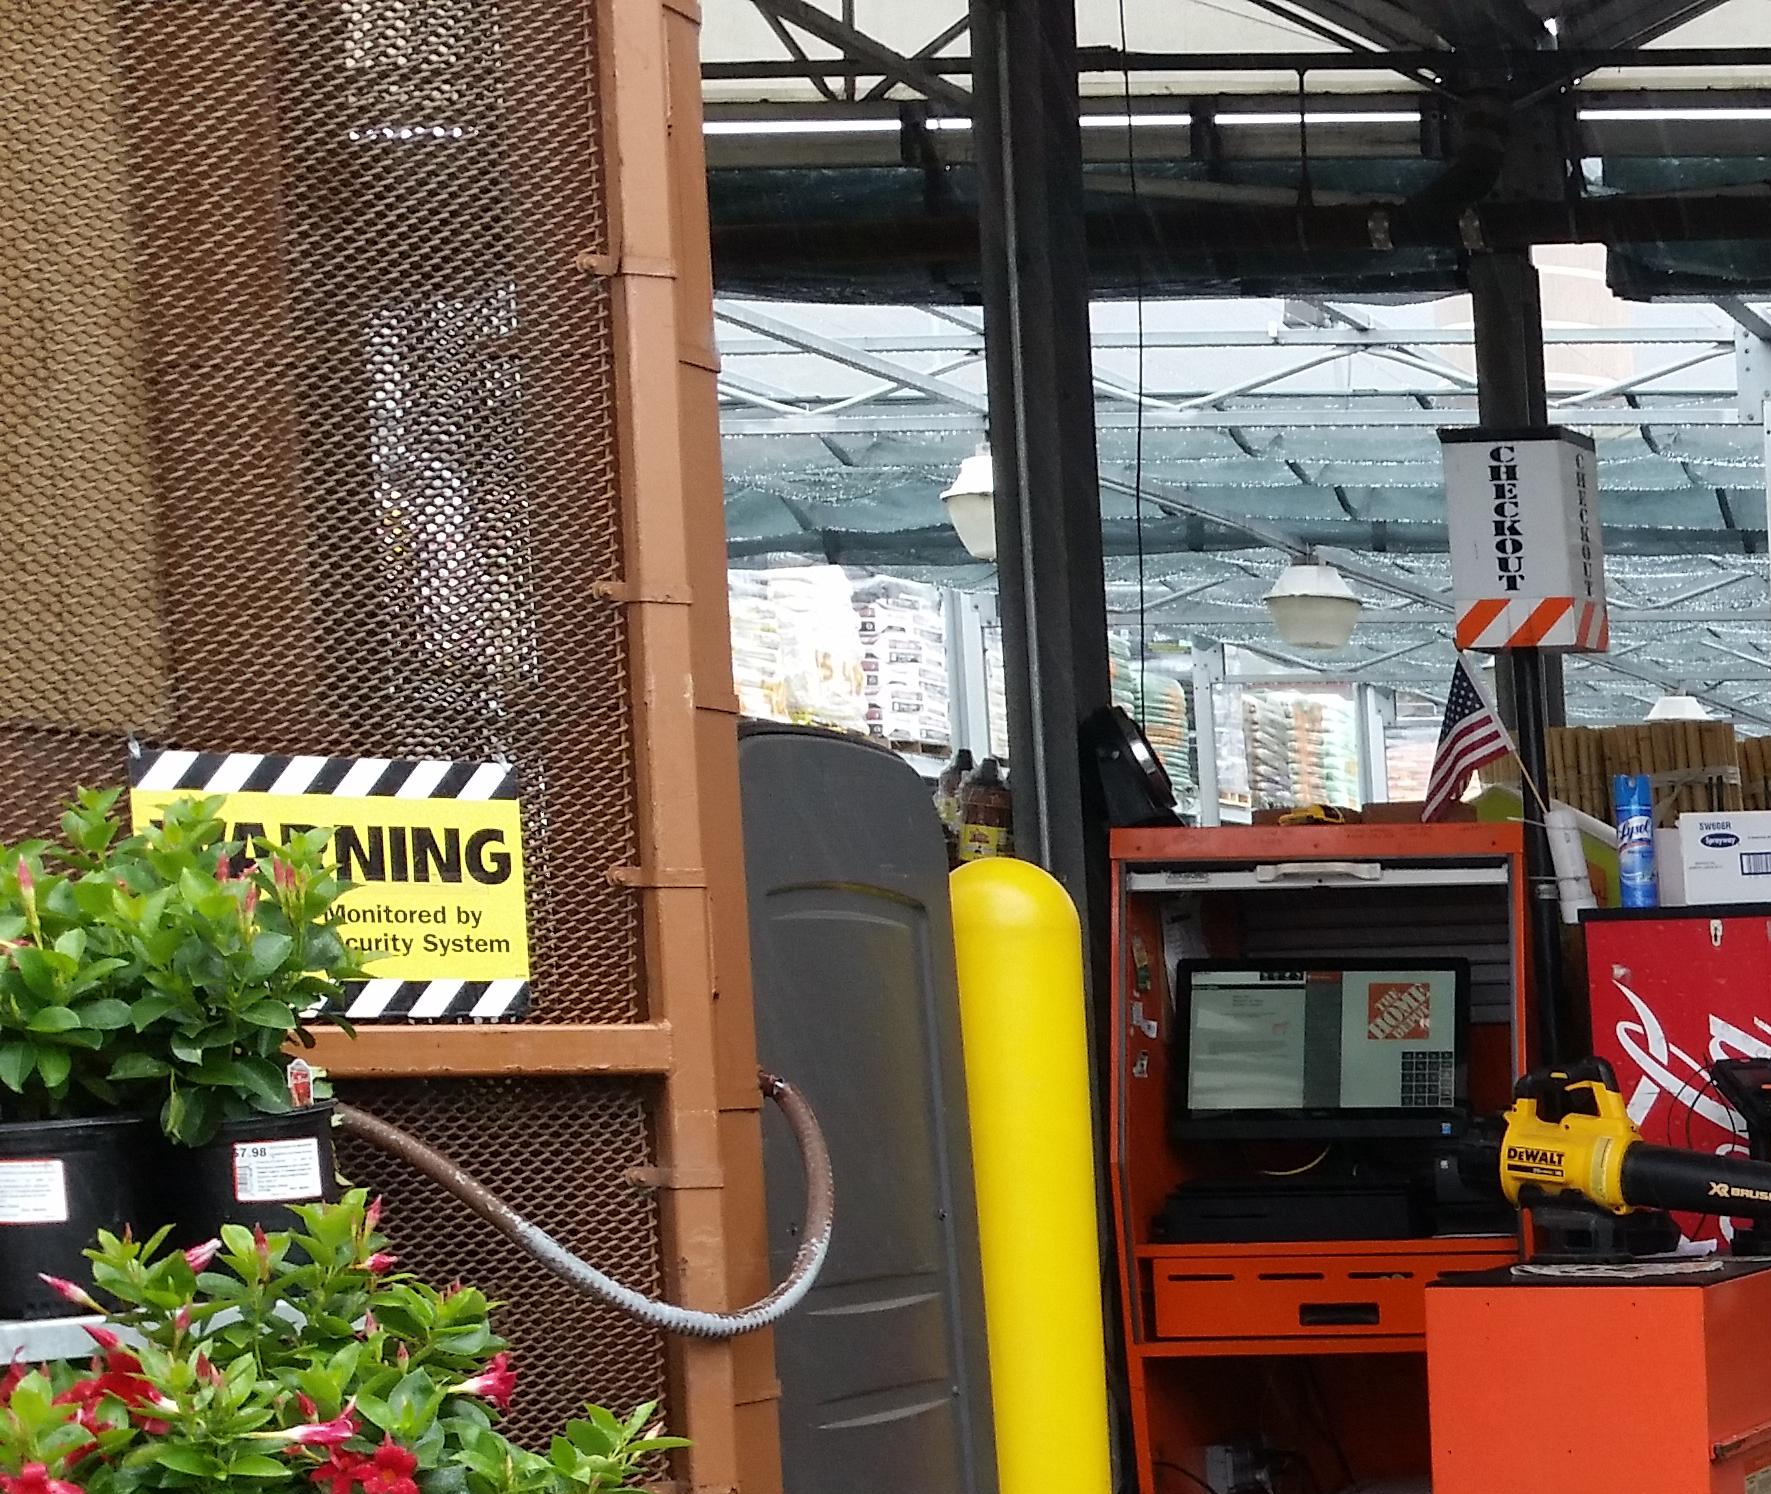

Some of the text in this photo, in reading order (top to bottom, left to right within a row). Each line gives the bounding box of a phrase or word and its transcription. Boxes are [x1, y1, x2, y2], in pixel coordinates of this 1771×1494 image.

[1488, 446, 1525, 592] CHECKOUT
[1575, 453, 1593, 597] CHECKOUT
[1618, 817, 1650, 840] Lysol
[457, 904, 482, 928] by
[345, 932, 511, 957] curity System
[1508, 1147, 1565, 1165] DEWALT
[1708, 1181, 1730, 1198] XR
